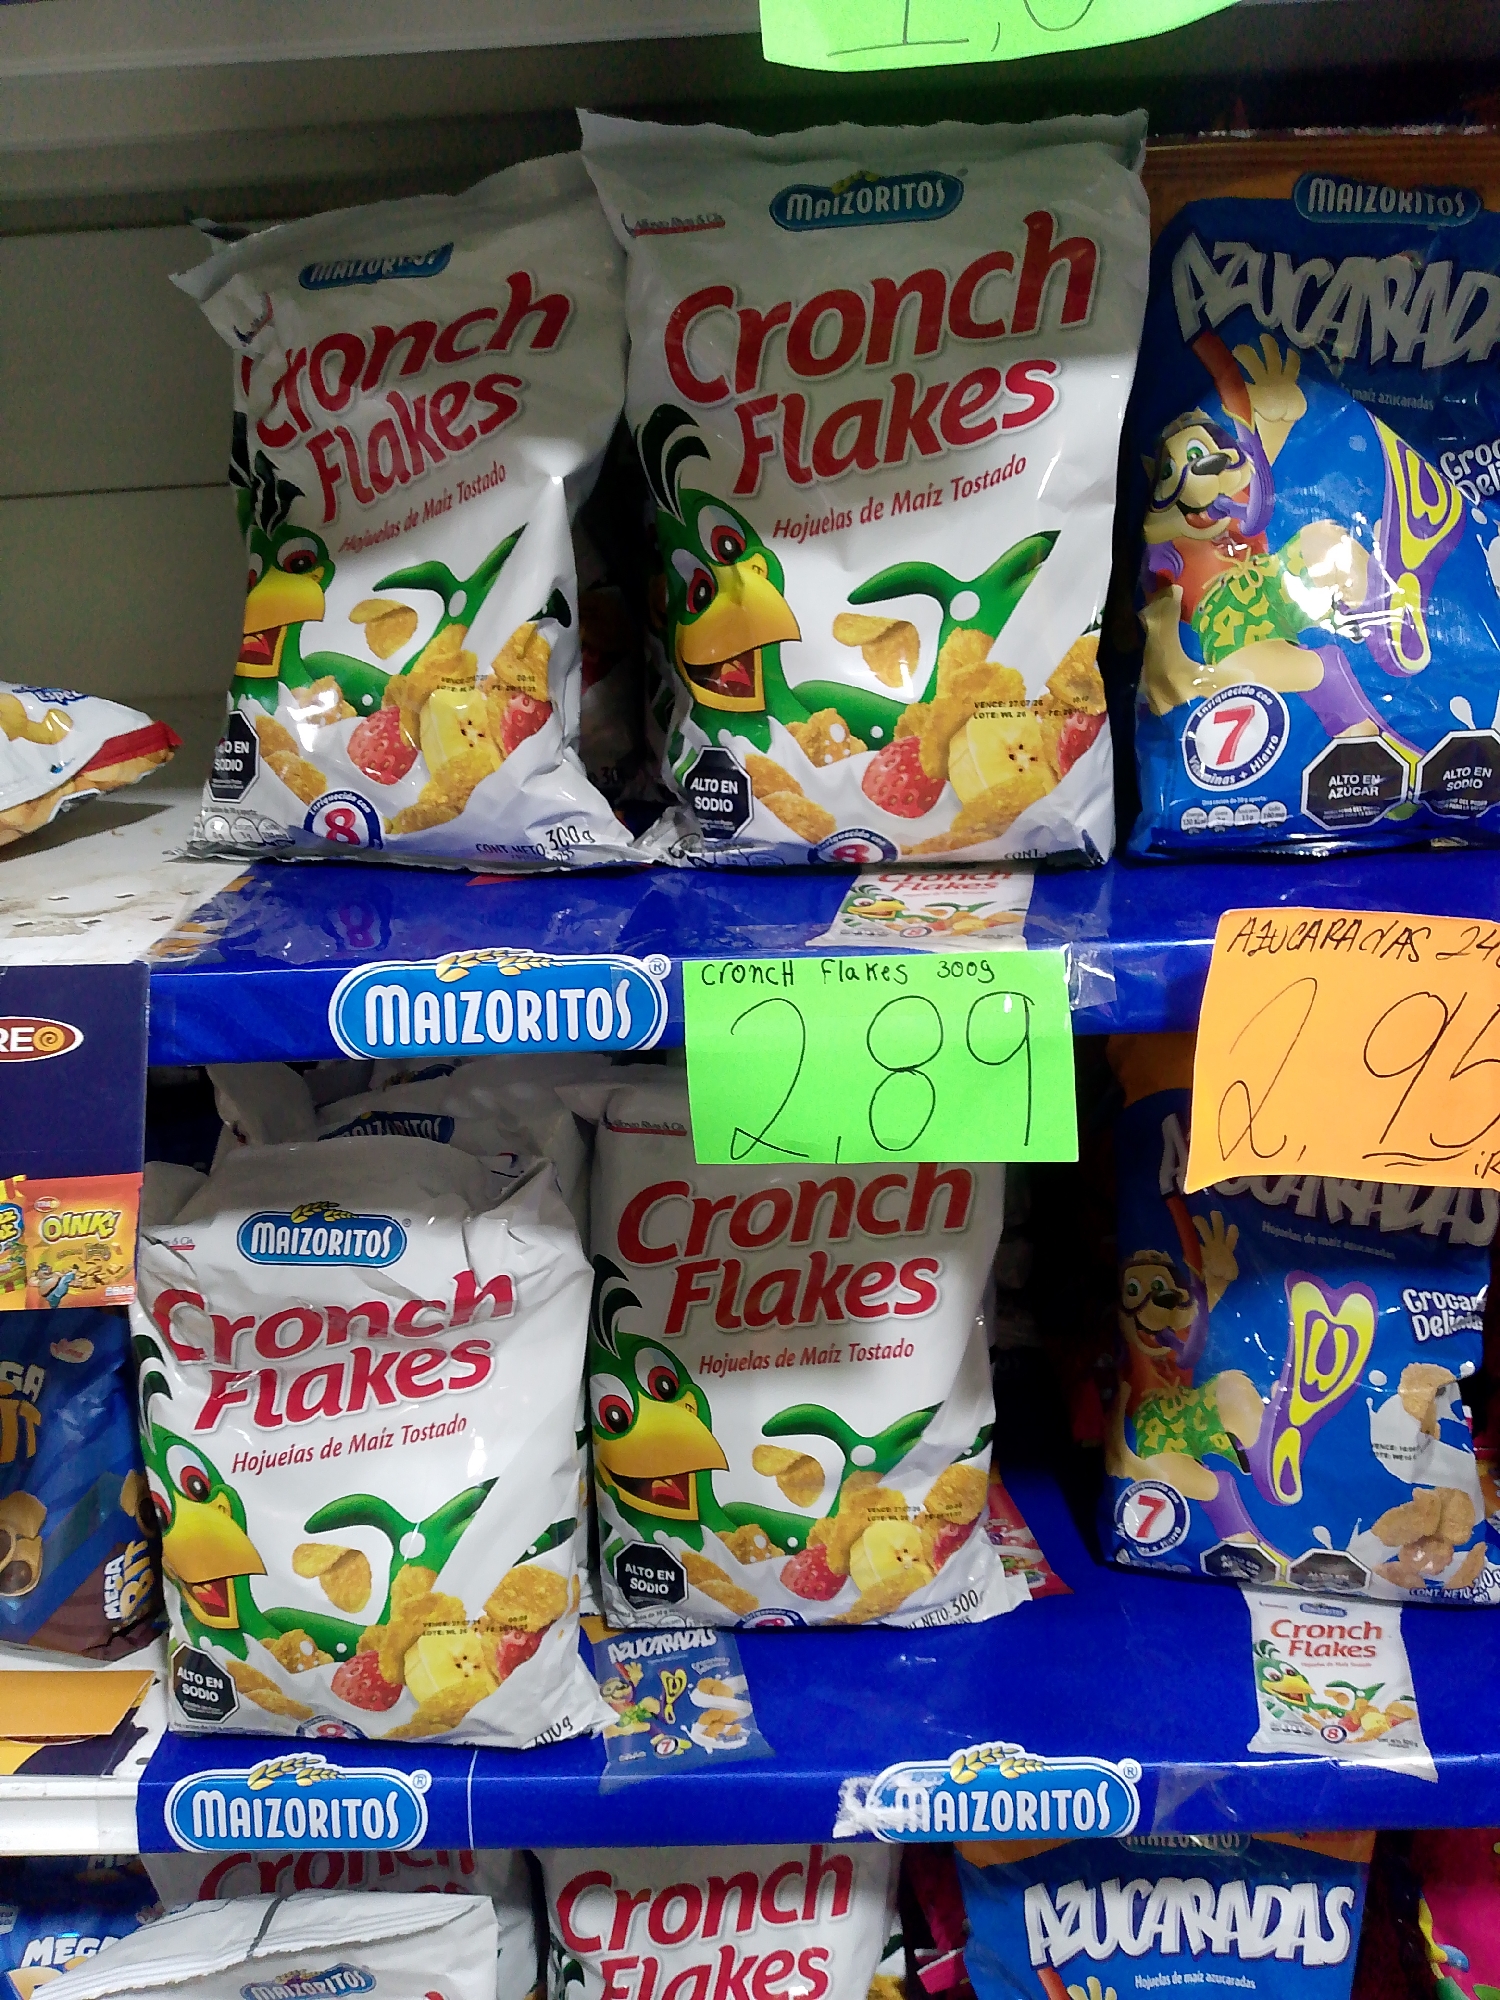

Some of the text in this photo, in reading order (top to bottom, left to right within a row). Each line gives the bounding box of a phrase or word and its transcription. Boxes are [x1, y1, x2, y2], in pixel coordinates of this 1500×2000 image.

[786, 179, 946, 221] MAIZORITOS
[1307, 177, 1466, 218] MAIZORITOS
[664, 210, 1098, 403] Cronch
[1172, 233, 1500, 369] AZUCARAD
[733, 359, 1058, 494] Flakes
[306, 373, 522, 522] Flakes
[403, 507, 419, 532] de
[456, 460, 507, 504] Tostado
[772, 507, 853, 543] Hojuelas
[859, 496, 884, 524] de
[950, 453, 1027, 502] Tostado
[1255, 690, 1274, 706] con
[234, 741, 250, 754] EN
[1214, 704, 1255, 765] 7
[214, 758, 244, 772] SODIO
[1328, 774, 1381, 787] ALTO EN
[1442, 766, 1493, 780] ALTO EN
[690, 777, 739, 795] ALTO EN
[694, 796, 734, 813] SODIO
[1446, 779, 1484, 793] SODIO
[325, 808, 361, 846] 8
[892, 881, 999, 892] Flakes
[937, 959, 995, 984] 300g
[364, 986, 632, 1046] MAIZORITOS
[731, 991, 1034, 1163] 2,89
[617, 1162, 971, 1265] Cronch
[250, 1221, 393, 1259] MAIZORITOS
[664, 1250, 939, 1334] Flakes
[153, 1270, 514, 1365] Cronch
[699, 1349, 771, 1378] Hojuelas
[774, 1347, 796, 1369] de
[848, 1338, 915, 1362] Tostado
[194, 1339, 492, 1431] Flakes
[320, 1437, 343, 1459] de
[401, 1413, 467, 1446] Tostado
[1137, 1493, 1167, 1539] 7
[104, 1554, 126, 1620] MEGA
[624, 1562, 676, 1582] ALTO EN
[629, 1577, 670, 1595] SODIO
[950, 1589, 984, 1617] 300
[1270, 1618, 1383, 1640] Cronch
[1288, 1639, 1377, 1658] Flakes
[177, 1666, 224, 1690] ALTO EN
[182, 1683, 219, 1703] SODIO
[661, 1740, 673, 1751] 7
[1327, 1728, 1339, 1740] 8
[192, 1790, 400, 1840] MAIZORITOS
[895, 1780, 1111, 1833] MAIZORITOS
[556, 1844, 854, 1953] Cronch
[1024, 1877, 1356, 1968] AZUCARADAS
[251, 1970, 367, 2000] MAIZORITOS
[600, 1945, 829, 2000] Flakes
[1171, 1970, 1183, 1985] de
